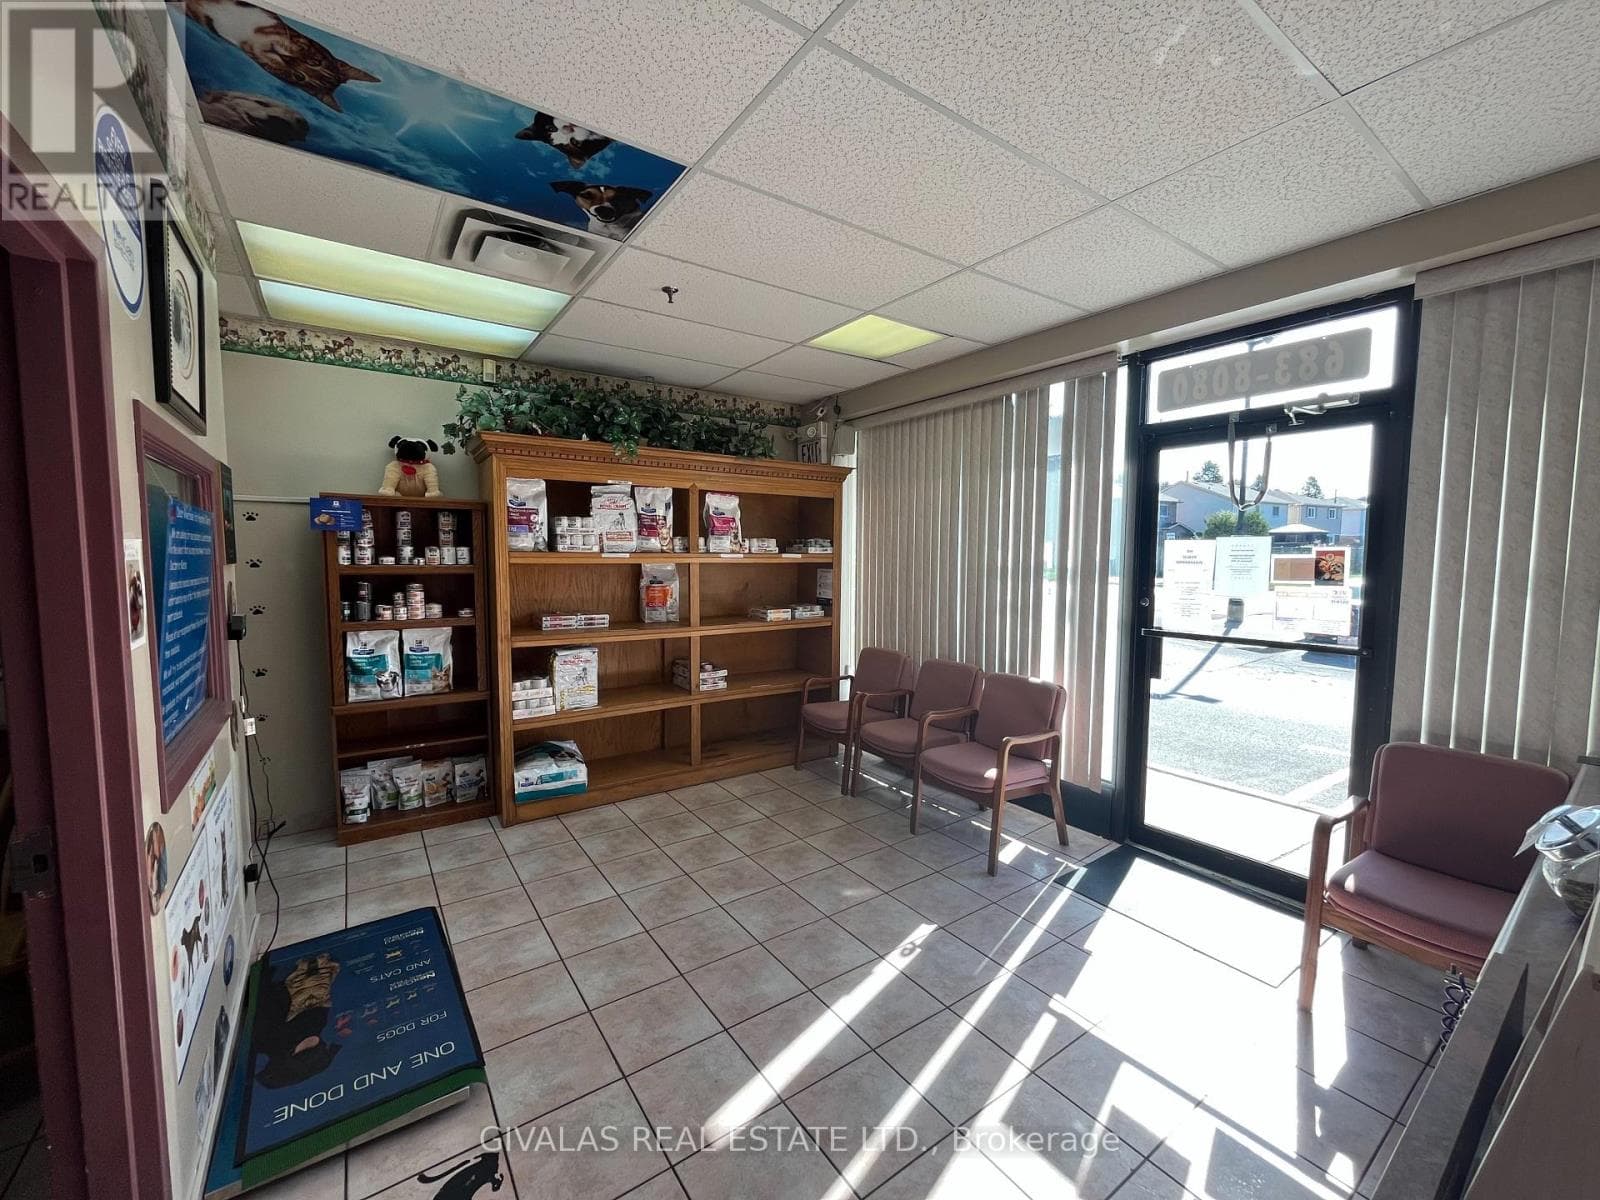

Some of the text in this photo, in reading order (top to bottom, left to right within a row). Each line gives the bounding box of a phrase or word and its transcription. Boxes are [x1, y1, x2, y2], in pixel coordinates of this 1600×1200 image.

[369, 958, 431, 983] AND CATS
[376, 1010, 447, 1042] FOR DOGS
[272, 1041, 455, 1125] ONE AND DONE
